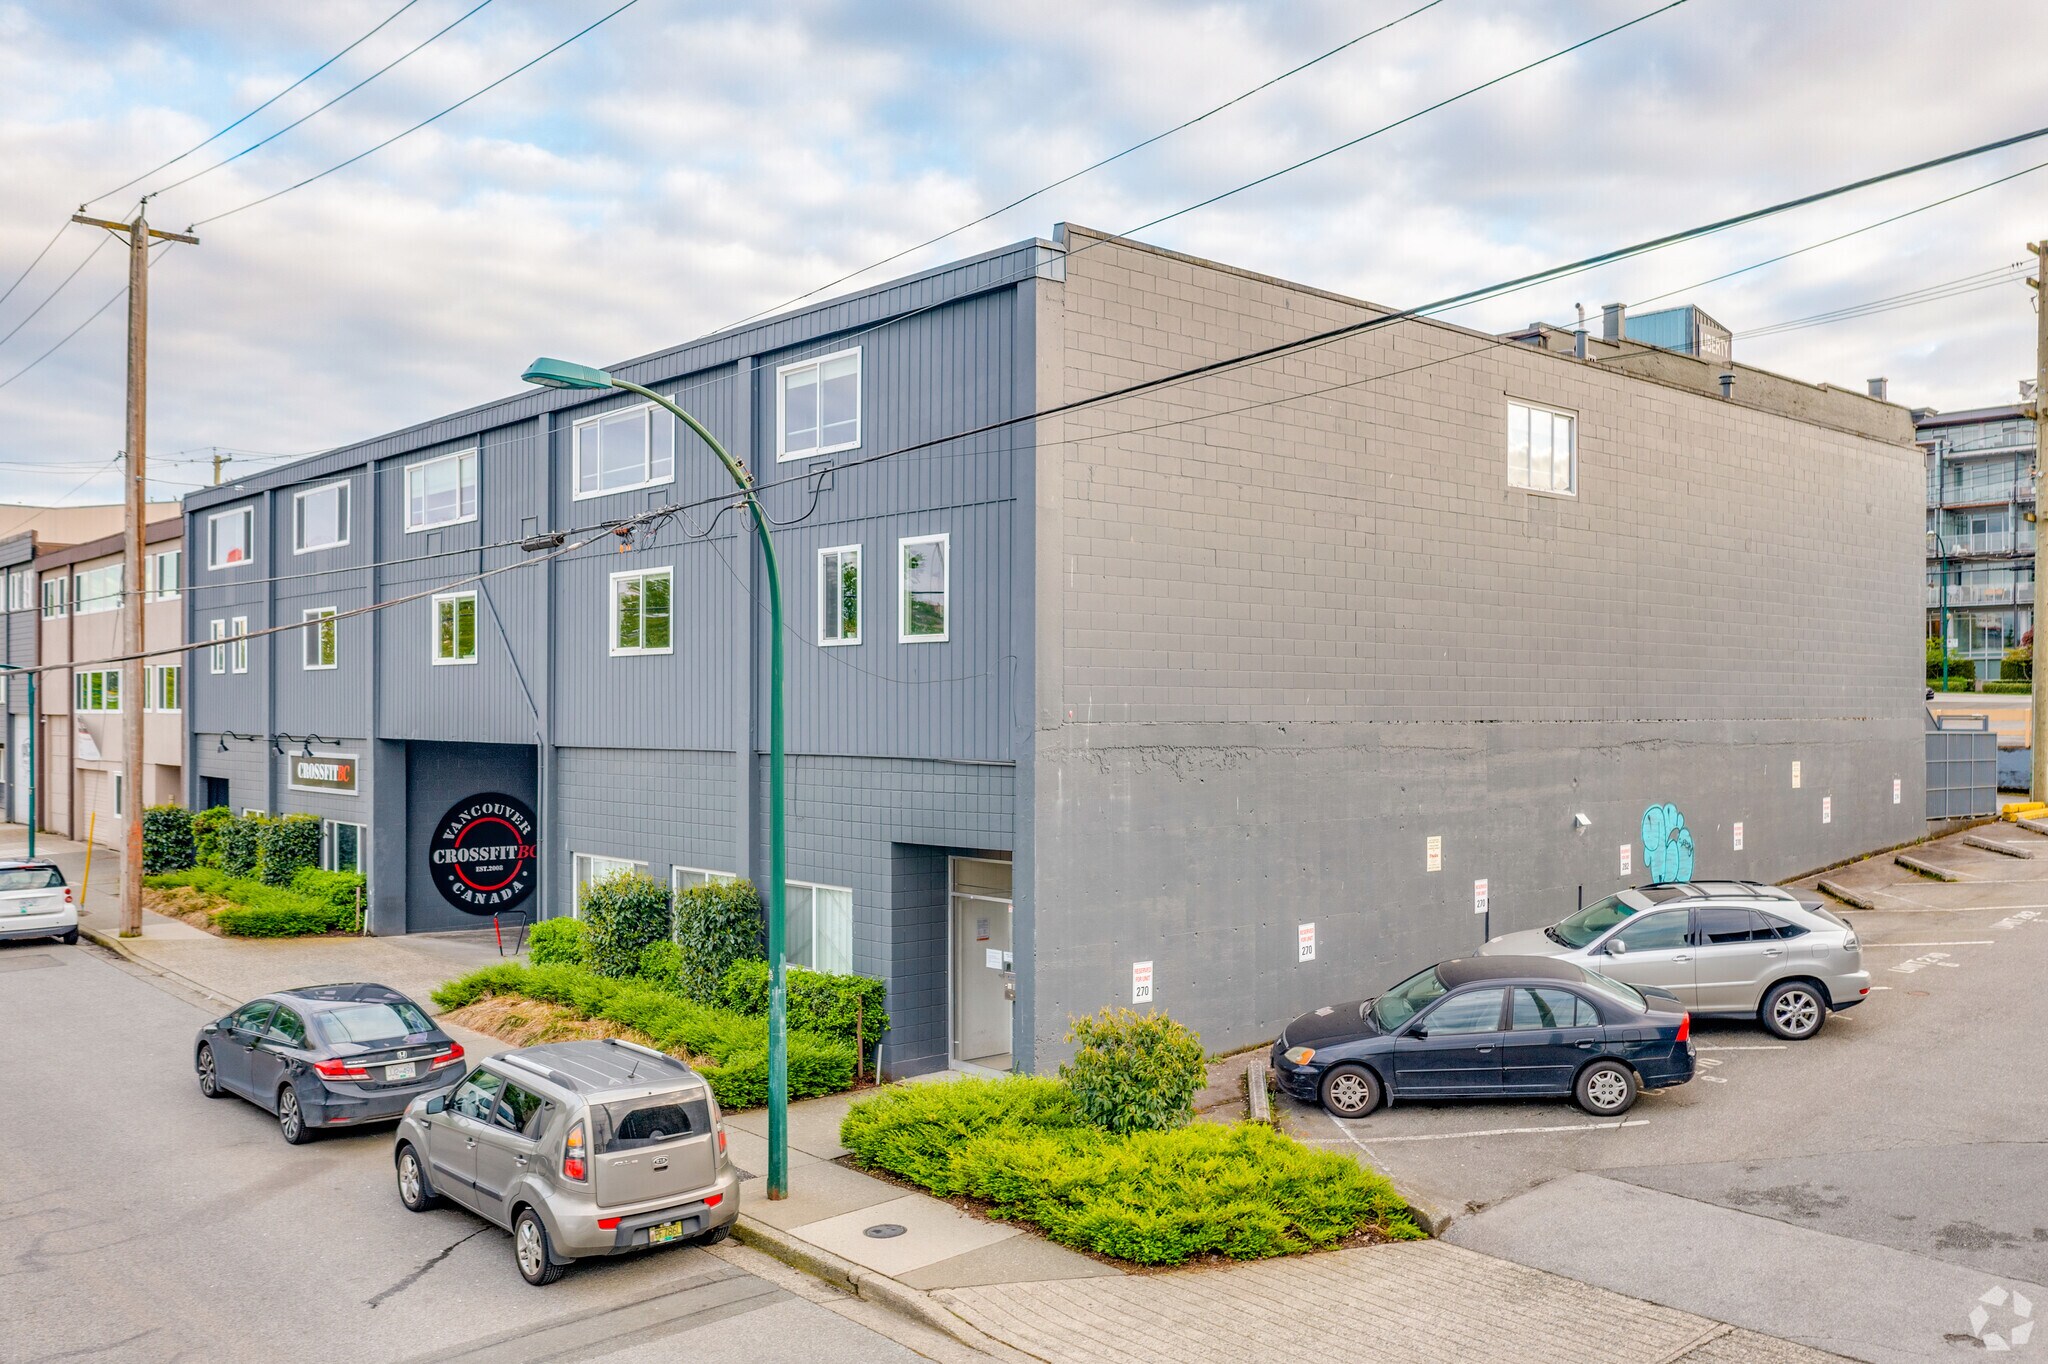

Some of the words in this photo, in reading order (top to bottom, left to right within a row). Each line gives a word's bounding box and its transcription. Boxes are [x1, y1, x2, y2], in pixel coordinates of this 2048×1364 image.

[443, 803, 531, 840] VANCOUVER
[452, 880, 524, 904] CANADA
[1302, 945, 1312, 955] 270
[1136, 985, 1149, 997] 270
